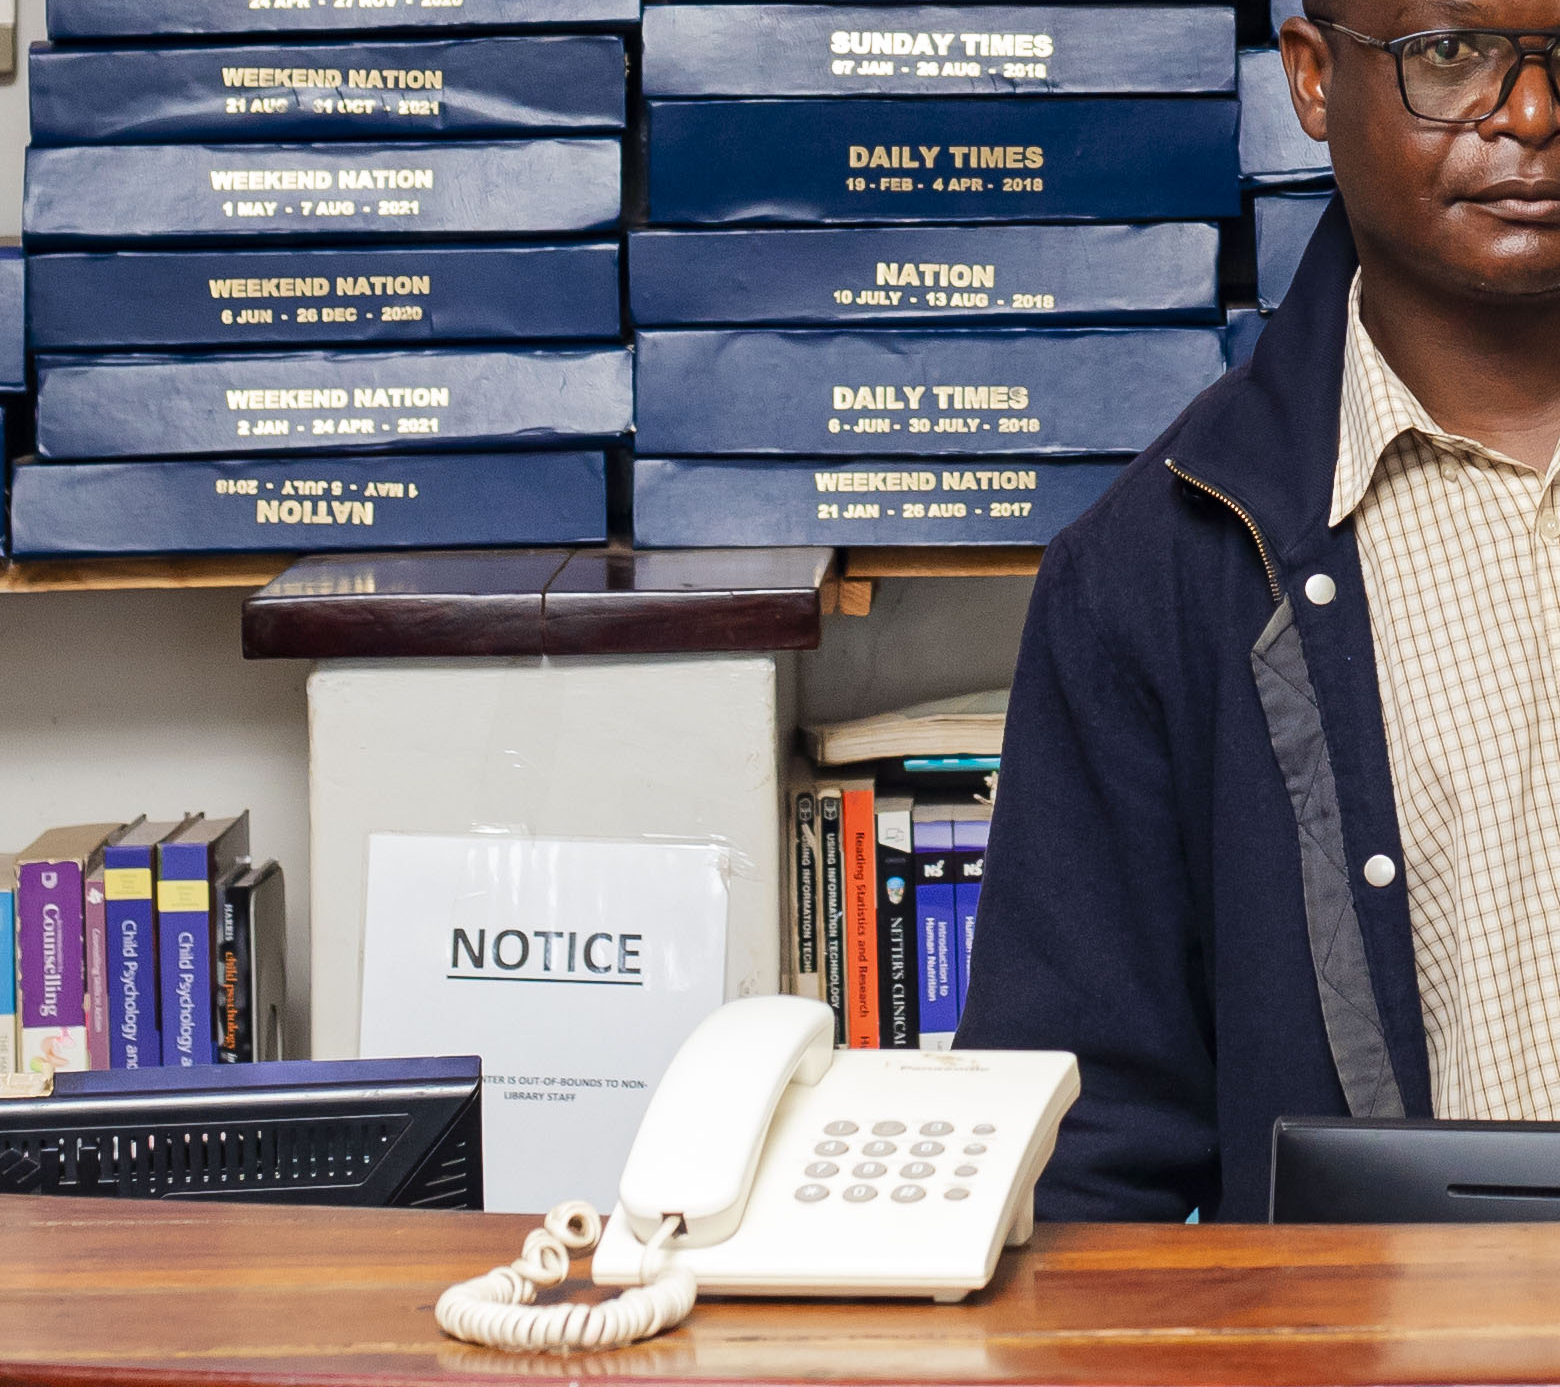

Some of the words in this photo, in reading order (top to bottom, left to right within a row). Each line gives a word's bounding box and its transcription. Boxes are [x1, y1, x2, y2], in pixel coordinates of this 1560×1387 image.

[831, 31, 955, 55] SUNDAY
[960, 34, 1053, 57] TIMES
[850, 146, 940, 168] DAILY
[949, 147, 1043, 168] TIMES
[211, 171, 332, 190] WEEKEND
[339, 170, 432, 189] NATION
[209, 278, 329, 298] WEEKEND
[337, 276, 429, 295] NATION
[877, 263, 994, 287] NATION
[834, 290, 852, 304] 10
[856, 291, 902, 305] JULY
[926, 292, 947, 306] 13
[950, 293, 988, 307] AUG
[1012, 294, 1057, 312] 2018
[257, 500, 373, 525] NATION
[827, 833, 835, 864] USING
[853, 832, 865, 880] Reading
[828, 868, 838, 937] INFORMATION
[856, 884, 867, 936] Statistics
[122, 920, 137, 957] Child
[451, 928, 642, 974] NOTICE
[857, 941, 866, 962] and
[41, 904, 62, 1017] Counselling
[830, 941, 840, 1008] TECHNOLOGY
[120, 962, 139, 1040] Psychology
[858, 965, 868, 1018] Research
[504, 1092, 544, 1100] LIBRARY
[547, 1093, 576, 1101] STAFF
[519, 1077, 602, 1087] OUT-OF-BOUNDS
[606, 1080, 618, 1088] TO
[621, 1080, 647, 1089] NON-
